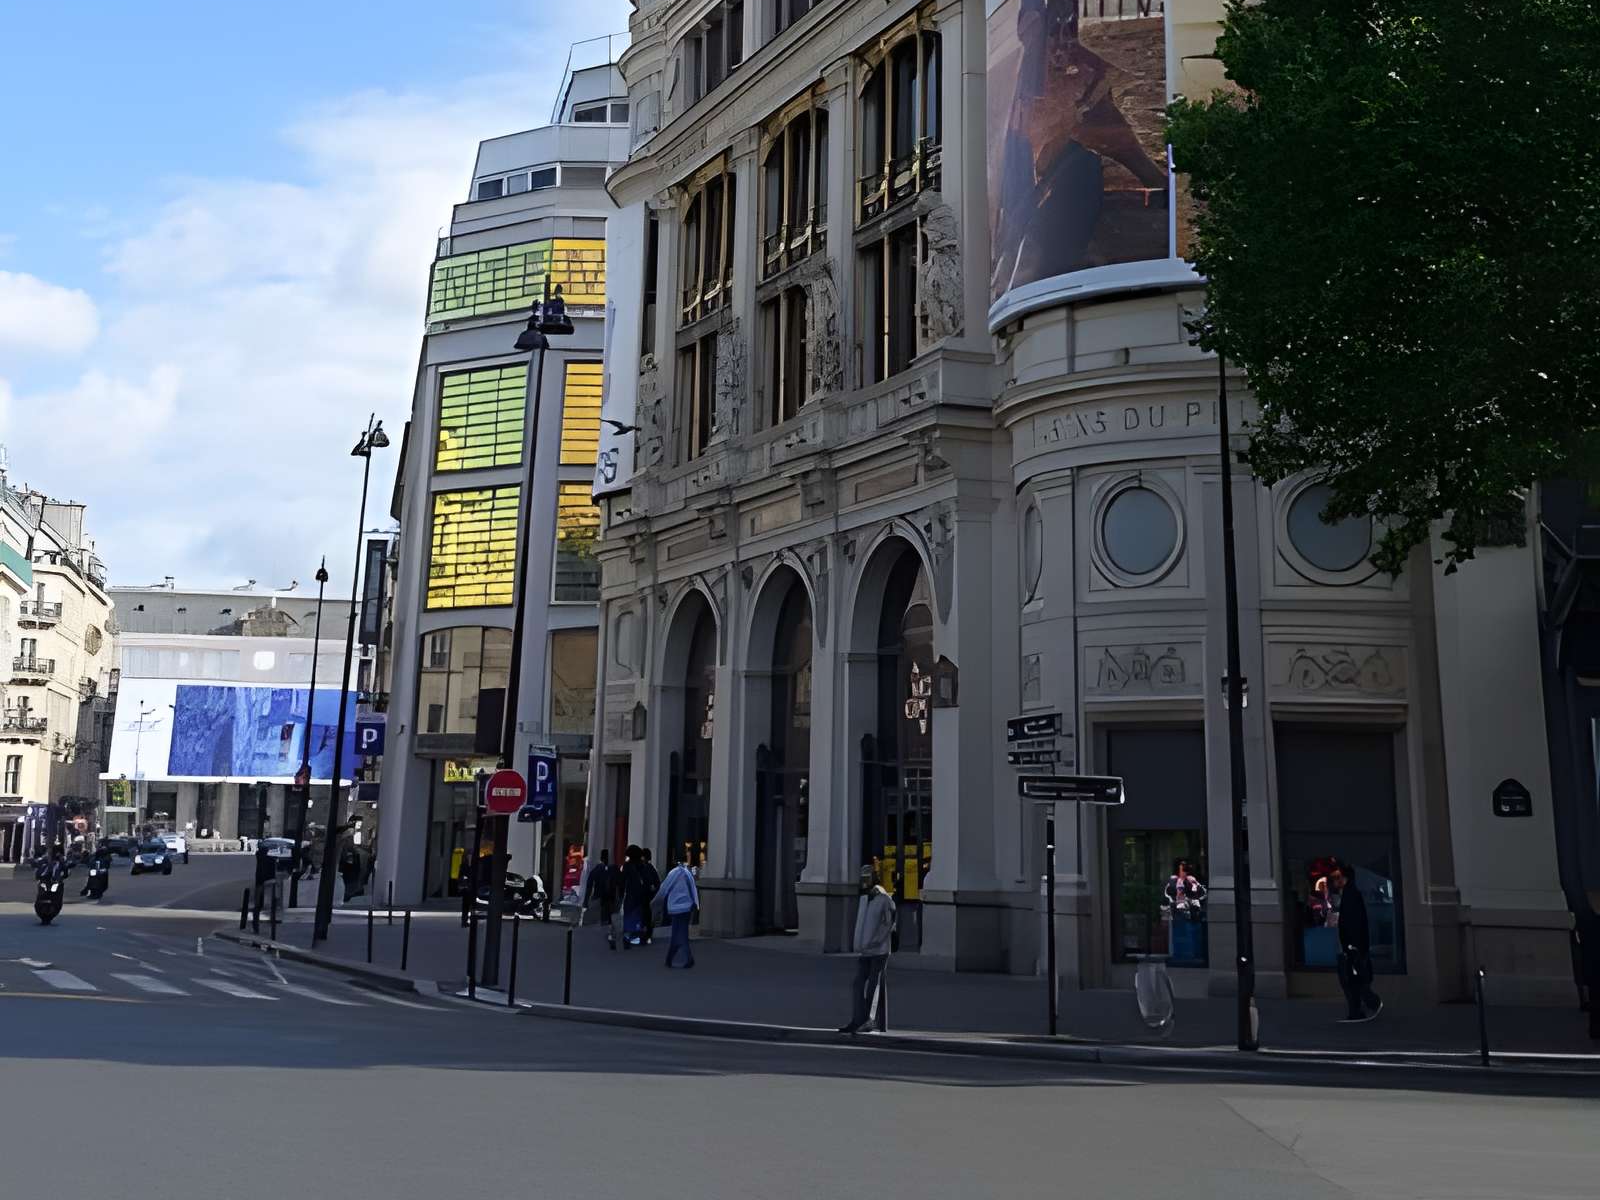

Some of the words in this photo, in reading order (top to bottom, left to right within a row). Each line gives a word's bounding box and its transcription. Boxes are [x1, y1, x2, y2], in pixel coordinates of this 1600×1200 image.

[1123, 405, 1165, 431] DU
[361, 727, 378, 749] P
[536, 760, 549, 793] P
